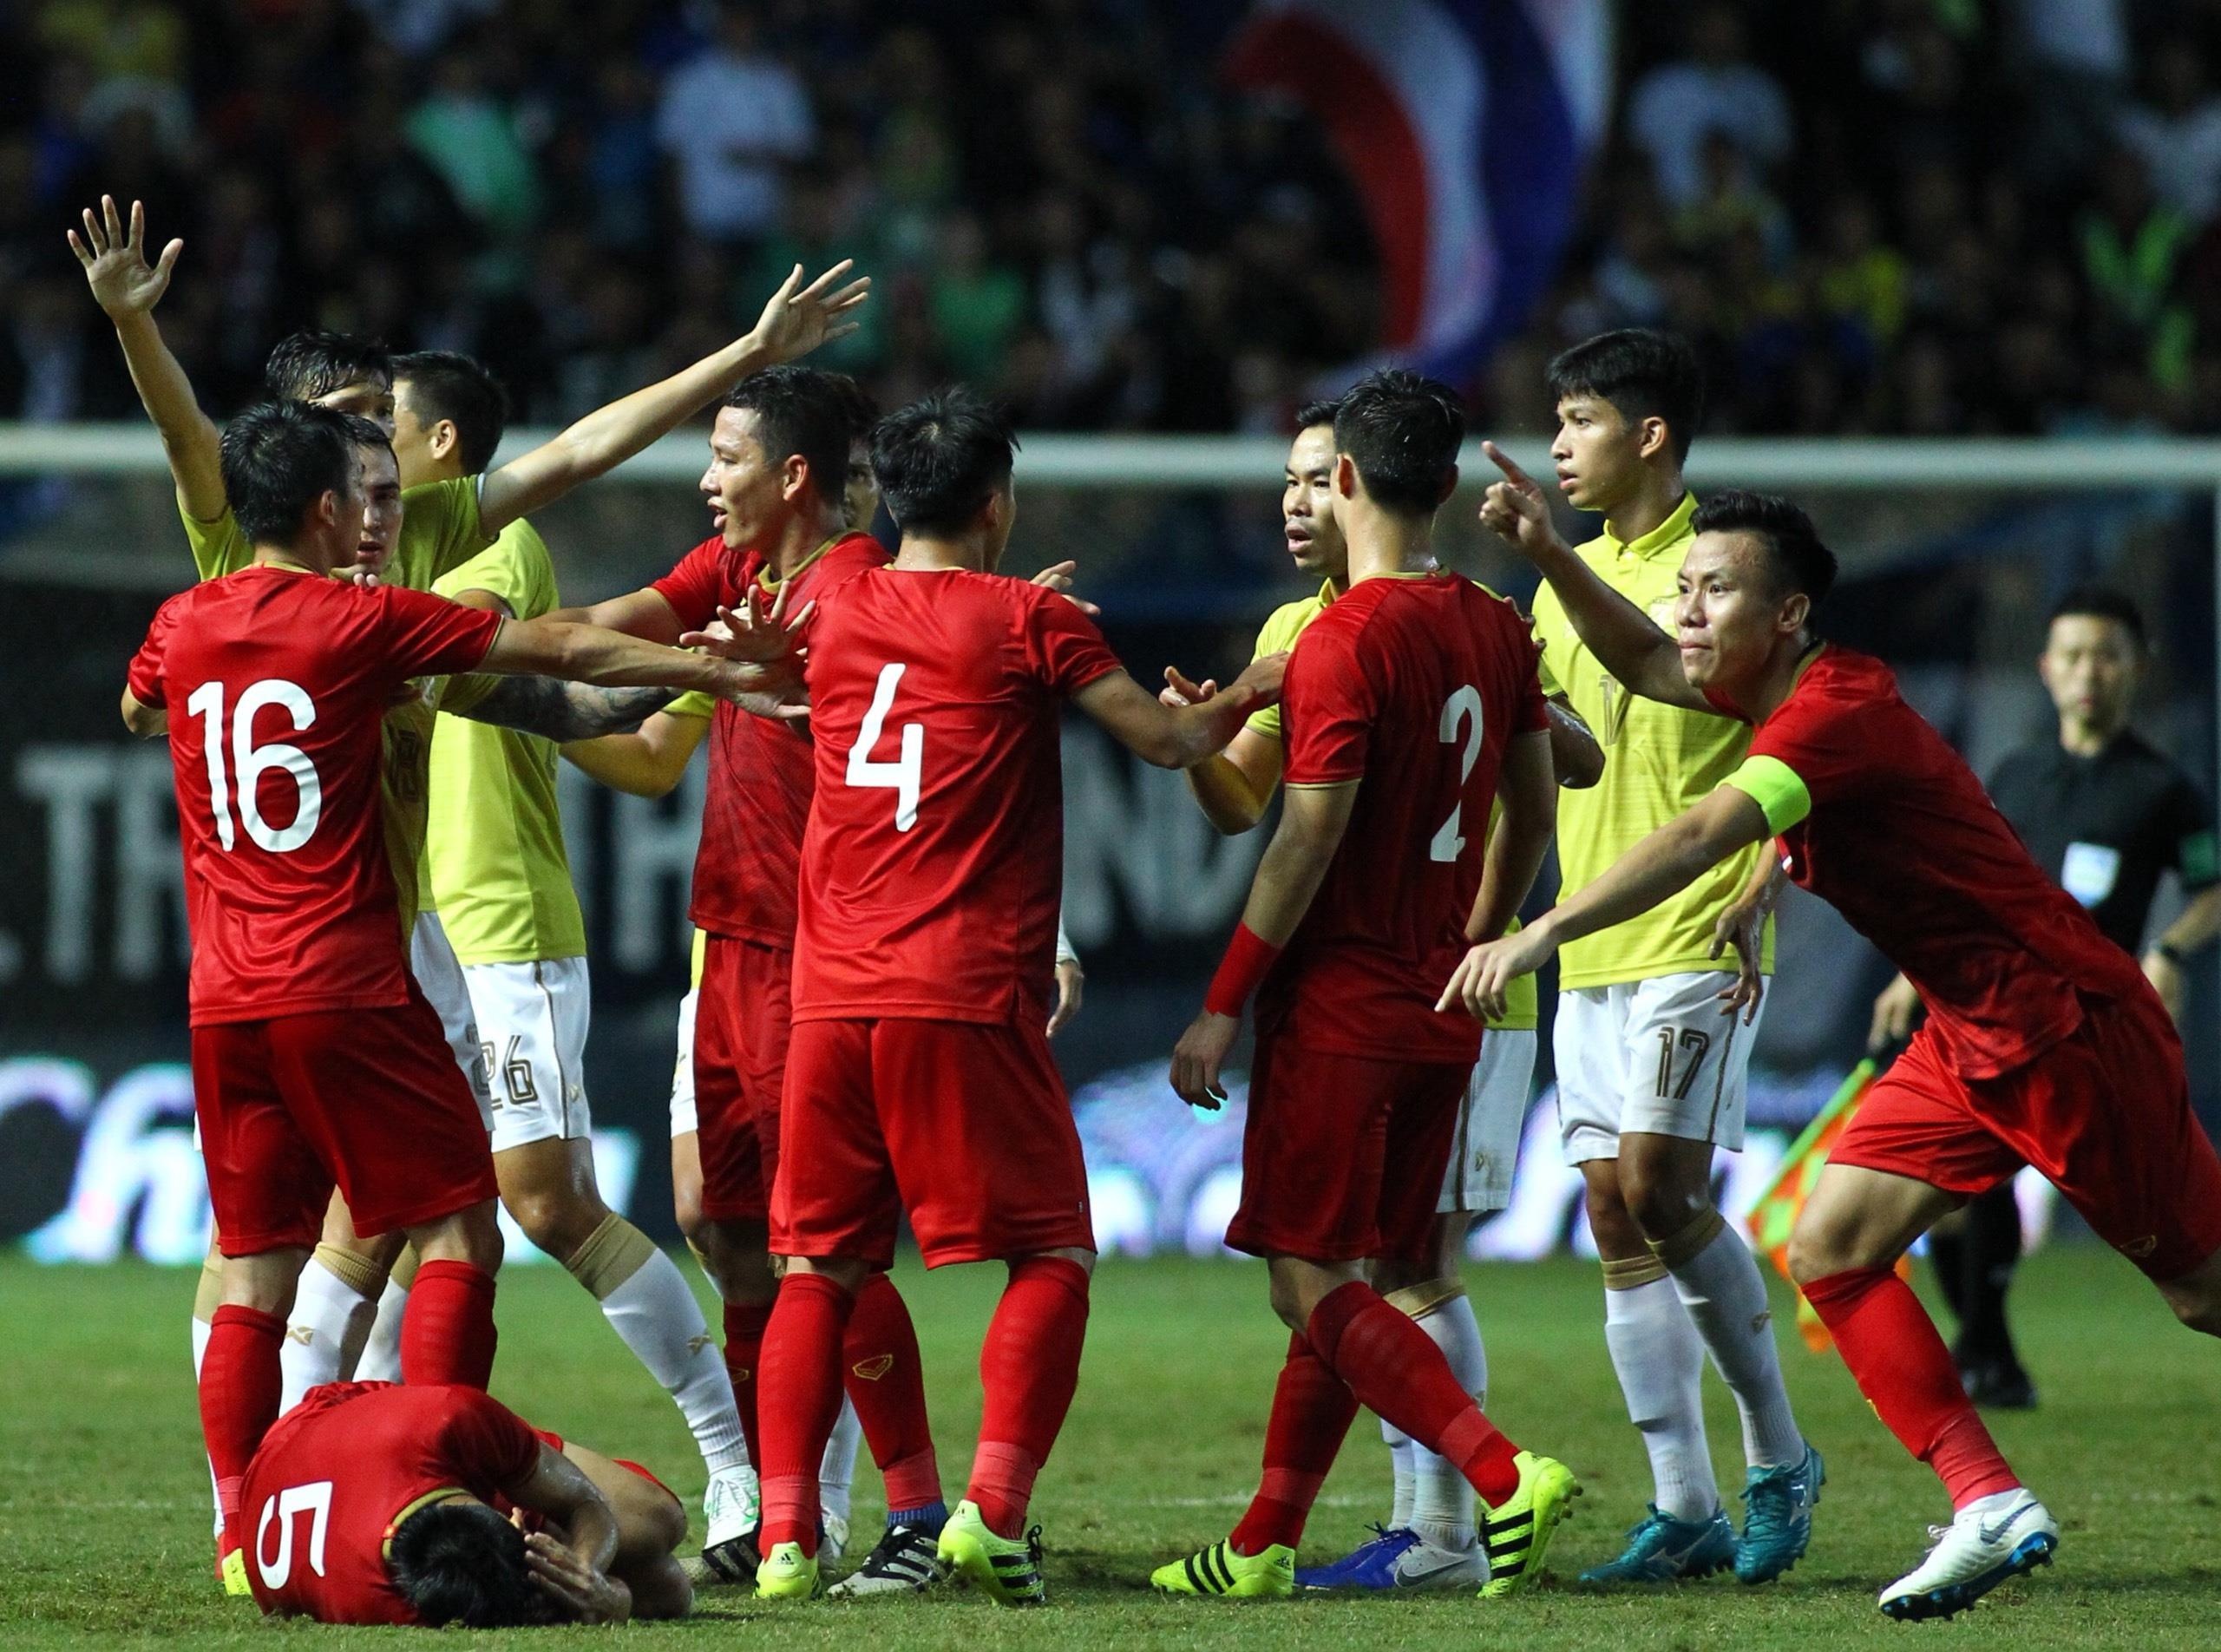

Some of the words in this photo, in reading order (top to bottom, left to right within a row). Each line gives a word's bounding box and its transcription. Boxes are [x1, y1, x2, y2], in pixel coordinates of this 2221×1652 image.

[187, 678, 322, 853] 16
[845, 662, 924, 833] 4
[1430, 684, 1484, 862] 2
[1656, 1026, 1710, 1101] 17
[256, 1480, 333, 1590] 5
